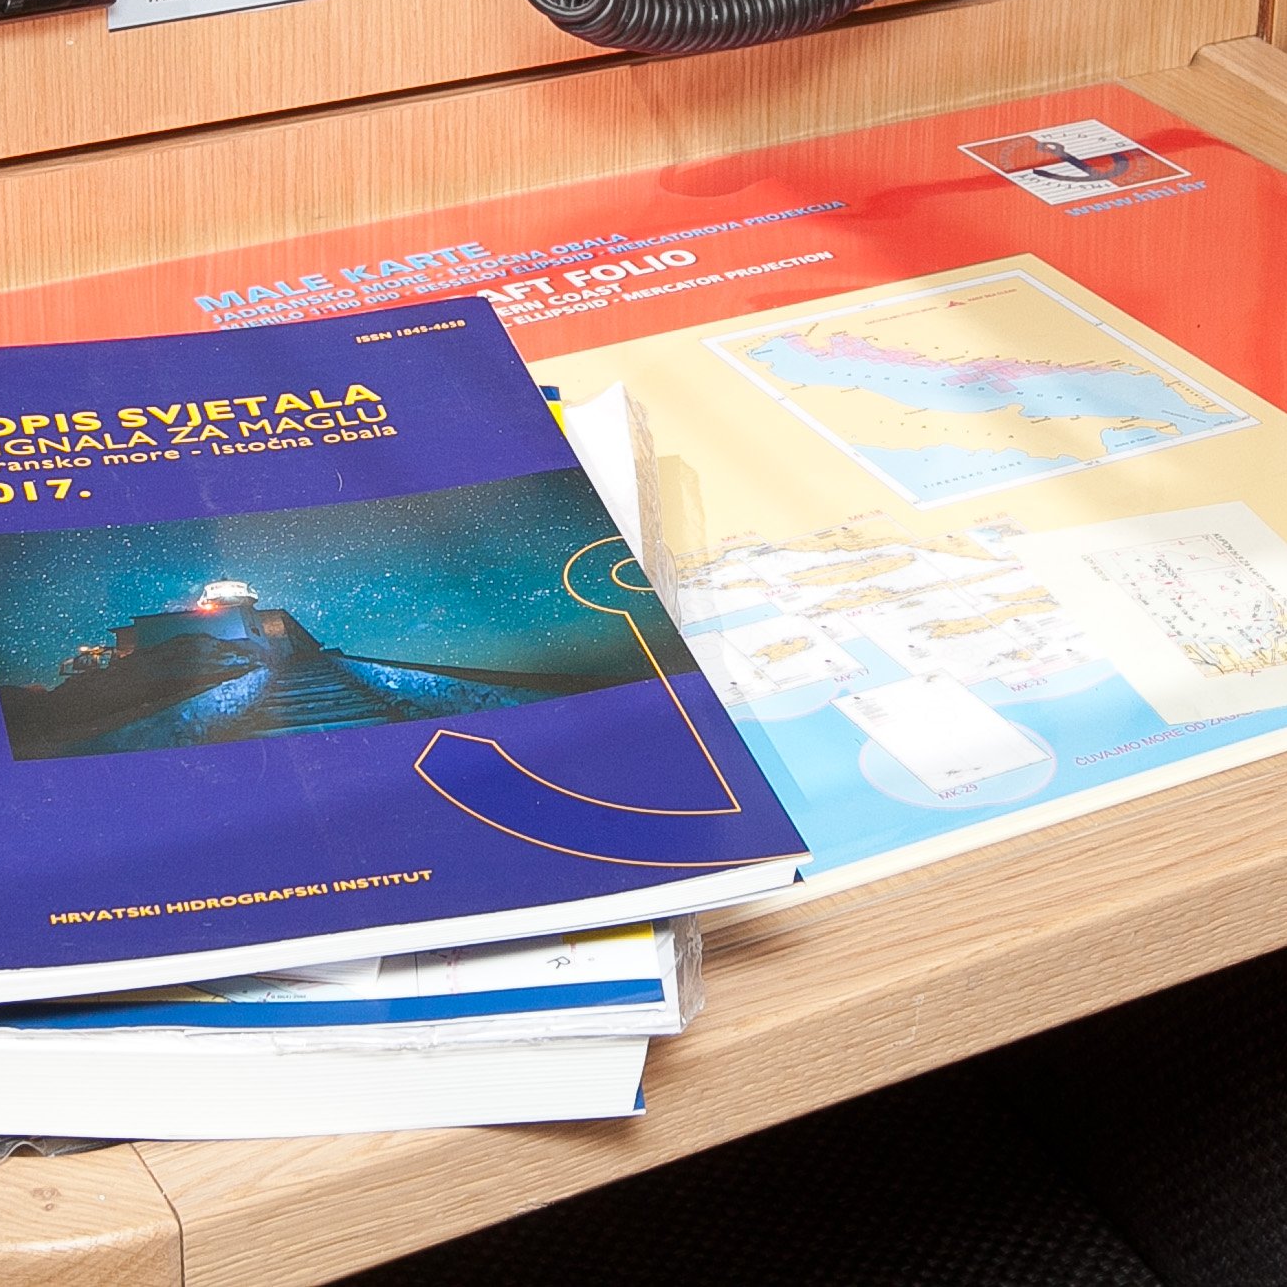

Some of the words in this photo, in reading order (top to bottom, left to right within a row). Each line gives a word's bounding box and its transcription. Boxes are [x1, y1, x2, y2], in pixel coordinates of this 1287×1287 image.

[416, 269, 509, 295] BESSELOV
[513, 250, 594, 274] ELIPSOID
[607, 220, 741, 255] MERCATOROVA
[743, 200, 847, 227] PROJEKCIJA
[563, 248, 698, 290] FOLIO
[193, 272, 335, 313] MALE
[340, 241, 492, 284] KARTE
[212, 288, 356, 324] JADRANSKO
[361, 272, 428, 294] MORE
[447, 249, 548, 277] ISTOČNA
[550, 233, 628, 255] OBALA
[513, 298, 609, 325] ELLIPSOID
[624, 273, 723, 302] MERCATOR
[725, 250, 835, 281] PROJECTION
[548, 282, 624, 307] COAST
[355, 330, 393, 345] ISSN
[116, 383, 382, 430] SVJETALA
[170, 424, 229, 445] ZA
[239, 404, 389, 434] MAGLU
[103, 448, 180, 465] more
[212, 434, 313, 456] Istočna
[323, 422, 398, 444] obala
[1141, 724, 1185, 747] MORE
[49, 904, 161, 926] HRVATSKI
[166, 883, 328, 914] HIDROGRAFSKI
[332, 870, 433, 893] INSTITUT
